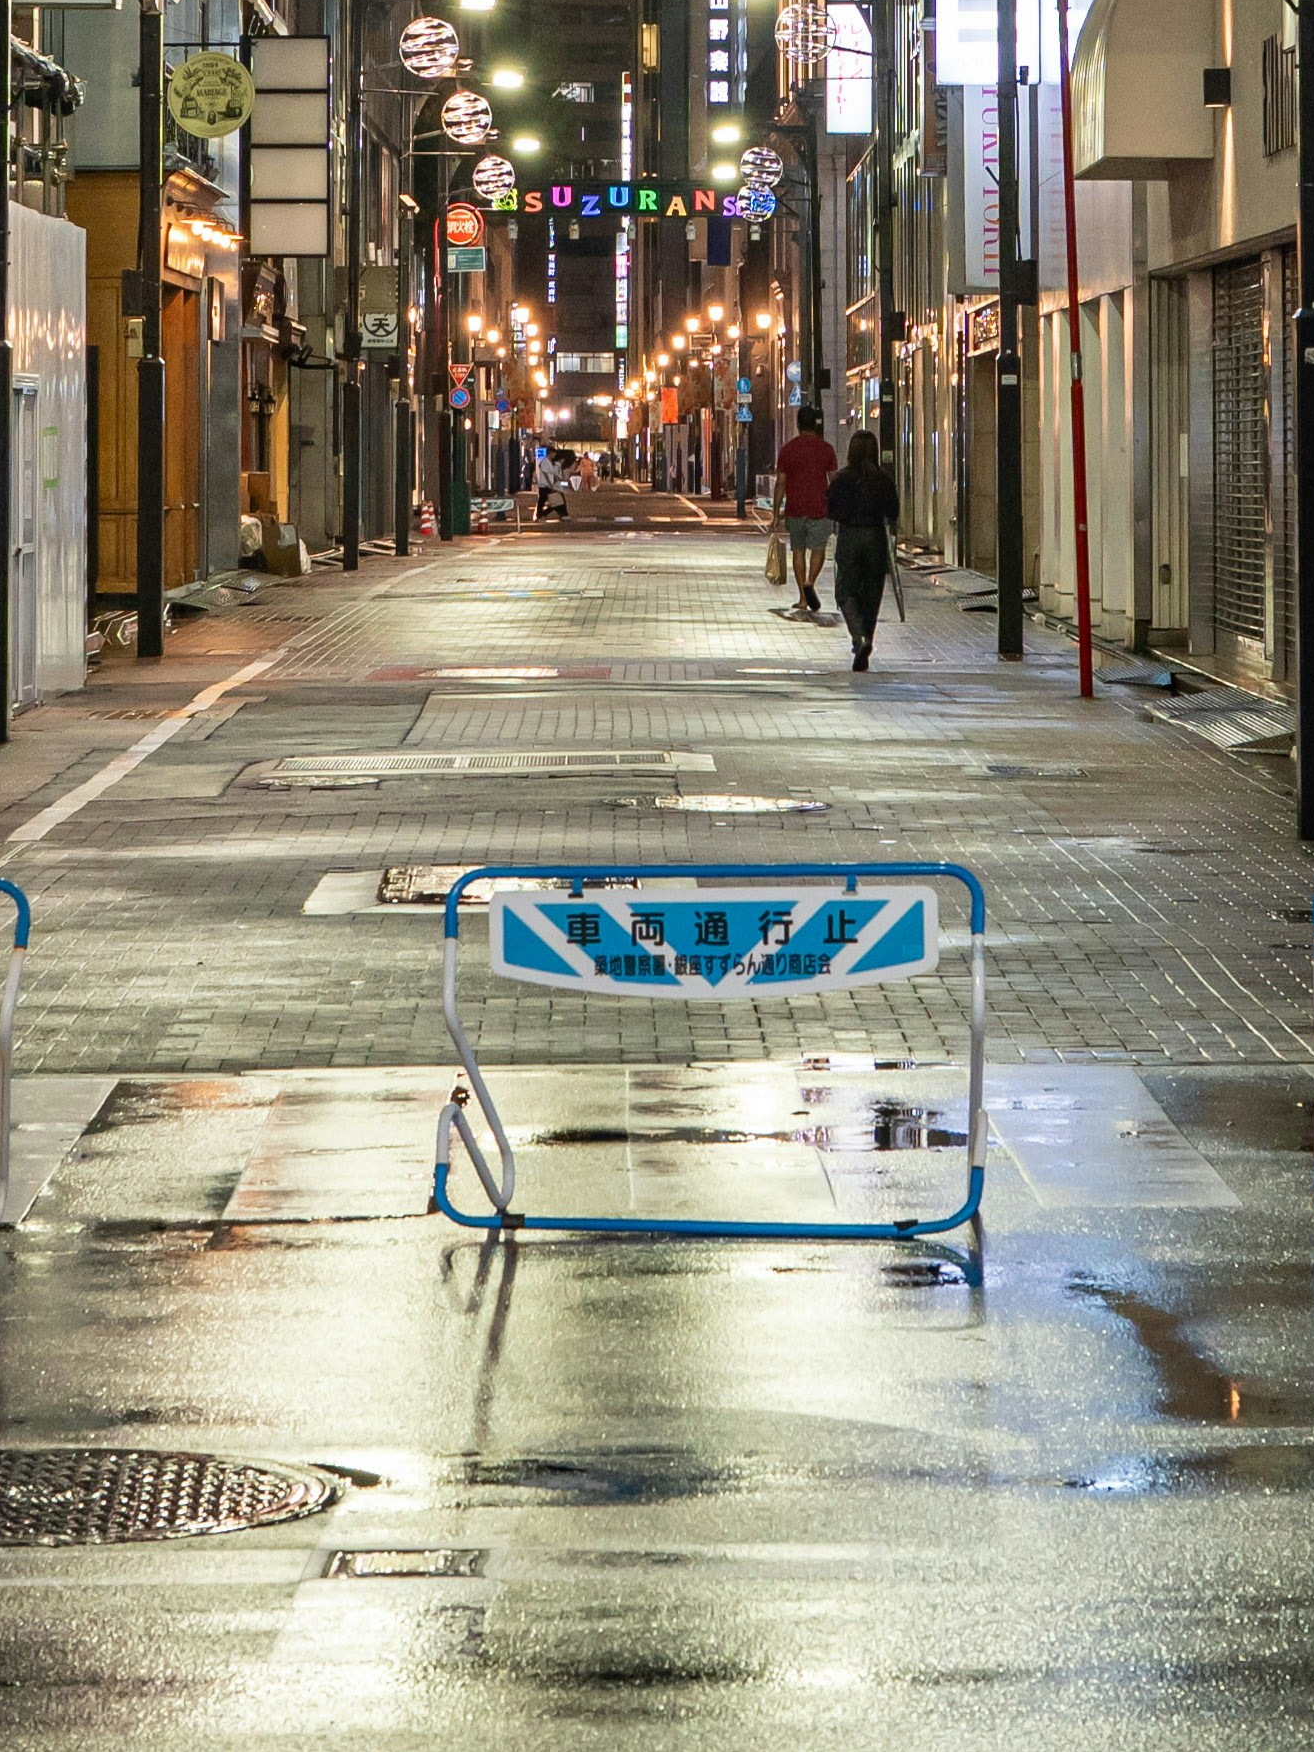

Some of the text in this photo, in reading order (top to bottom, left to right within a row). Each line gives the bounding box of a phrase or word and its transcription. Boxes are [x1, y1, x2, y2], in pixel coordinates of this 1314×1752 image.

[524, 186, 716, 217] SUZURAN
[566, 909, 859, 946] 車両通行止
